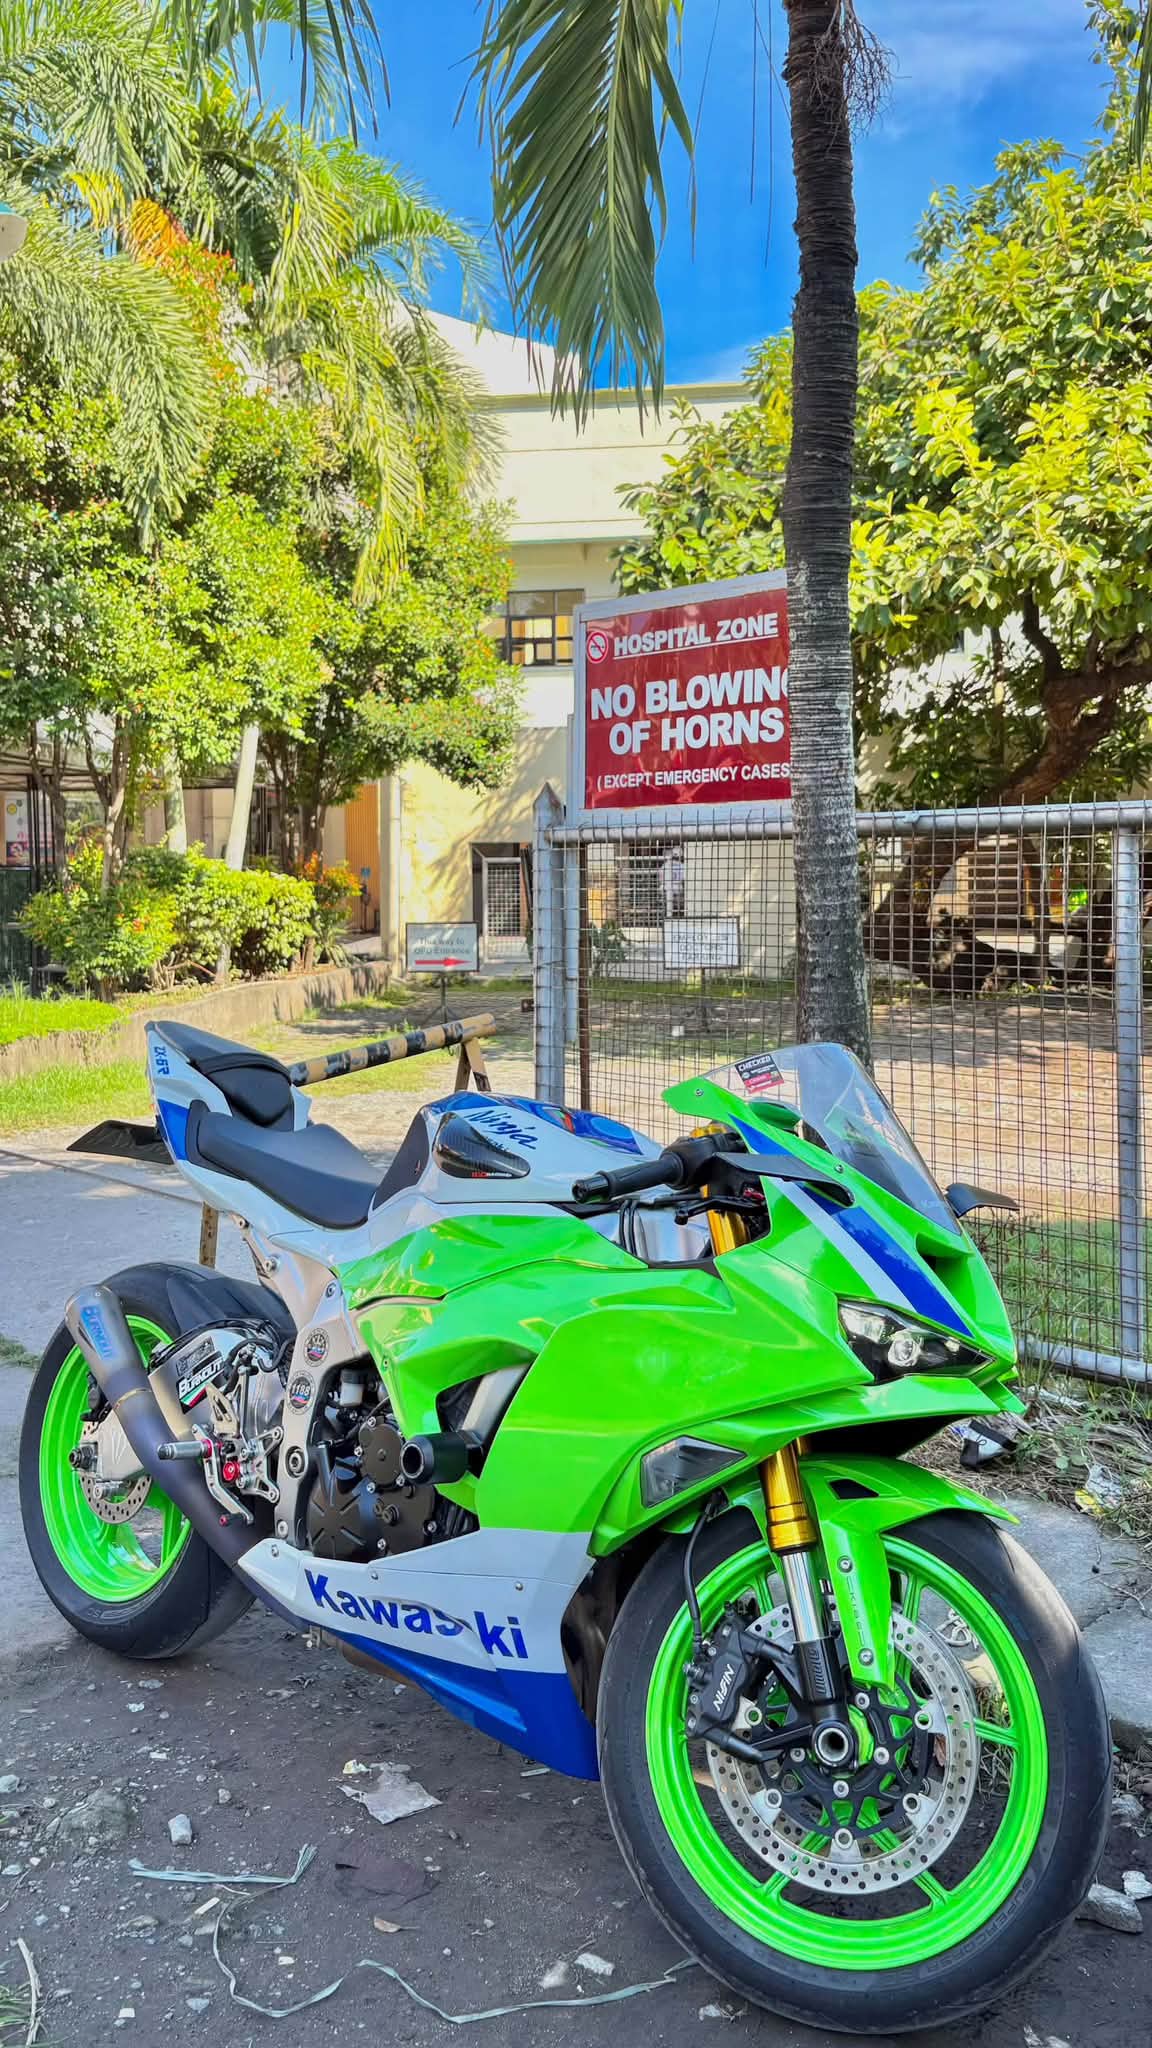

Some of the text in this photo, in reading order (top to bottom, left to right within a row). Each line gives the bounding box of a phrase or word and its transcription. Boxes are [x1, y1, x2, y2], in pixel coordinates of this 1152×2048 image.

[613, 612, 778, 656] HOSPITAL ZONE
[590, 684, 636, 720] NO
[609, 707, 785, 756] OF HORNS
[655, 766, 739, 786] EMERGENCY
[463, 1110, 539, 1150] Ninja
[304, 1568, 529, 1659] Kawaski
